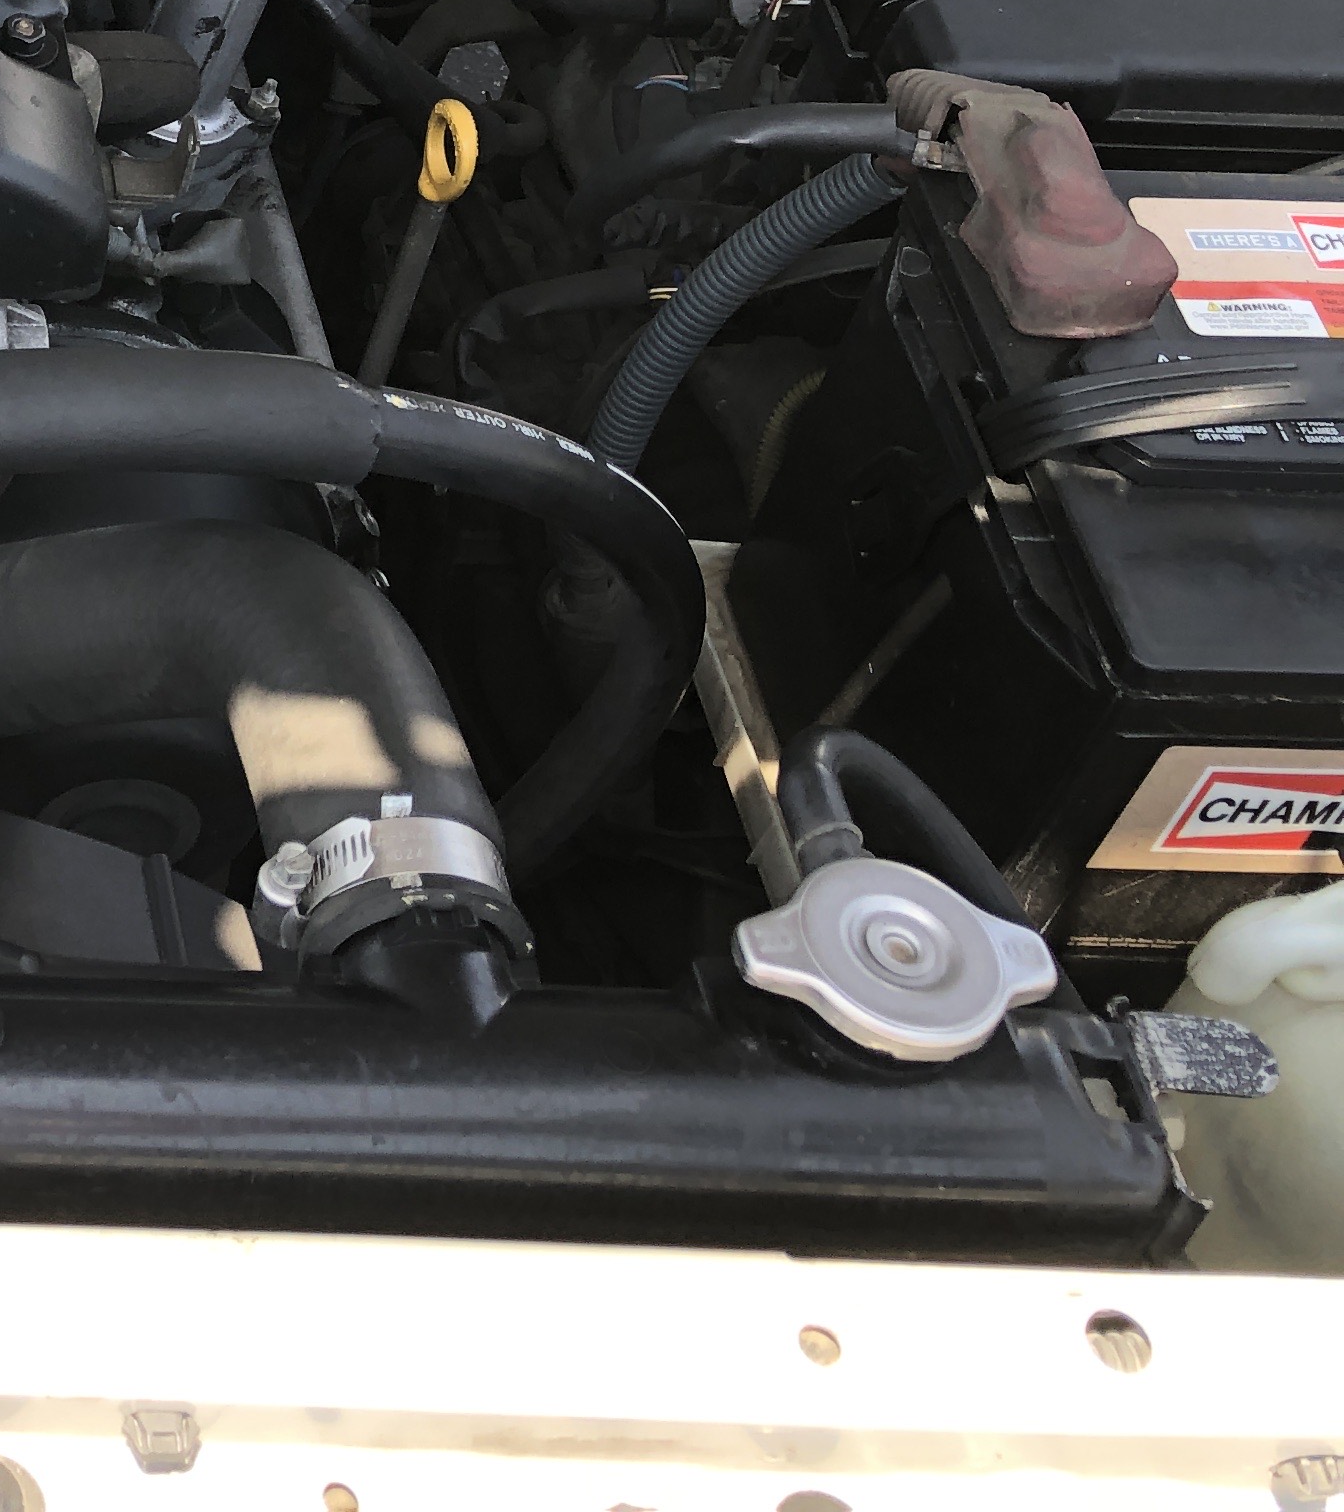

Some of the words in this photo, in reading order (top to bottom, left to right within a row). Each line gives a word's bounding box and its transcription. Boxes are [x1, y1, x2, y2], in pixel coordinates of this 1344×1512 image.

[1198, 234, 1281, 247] THERE'S
[1286, 236, 1298, 248] A
[1310, 233, 1344, 251] CH
